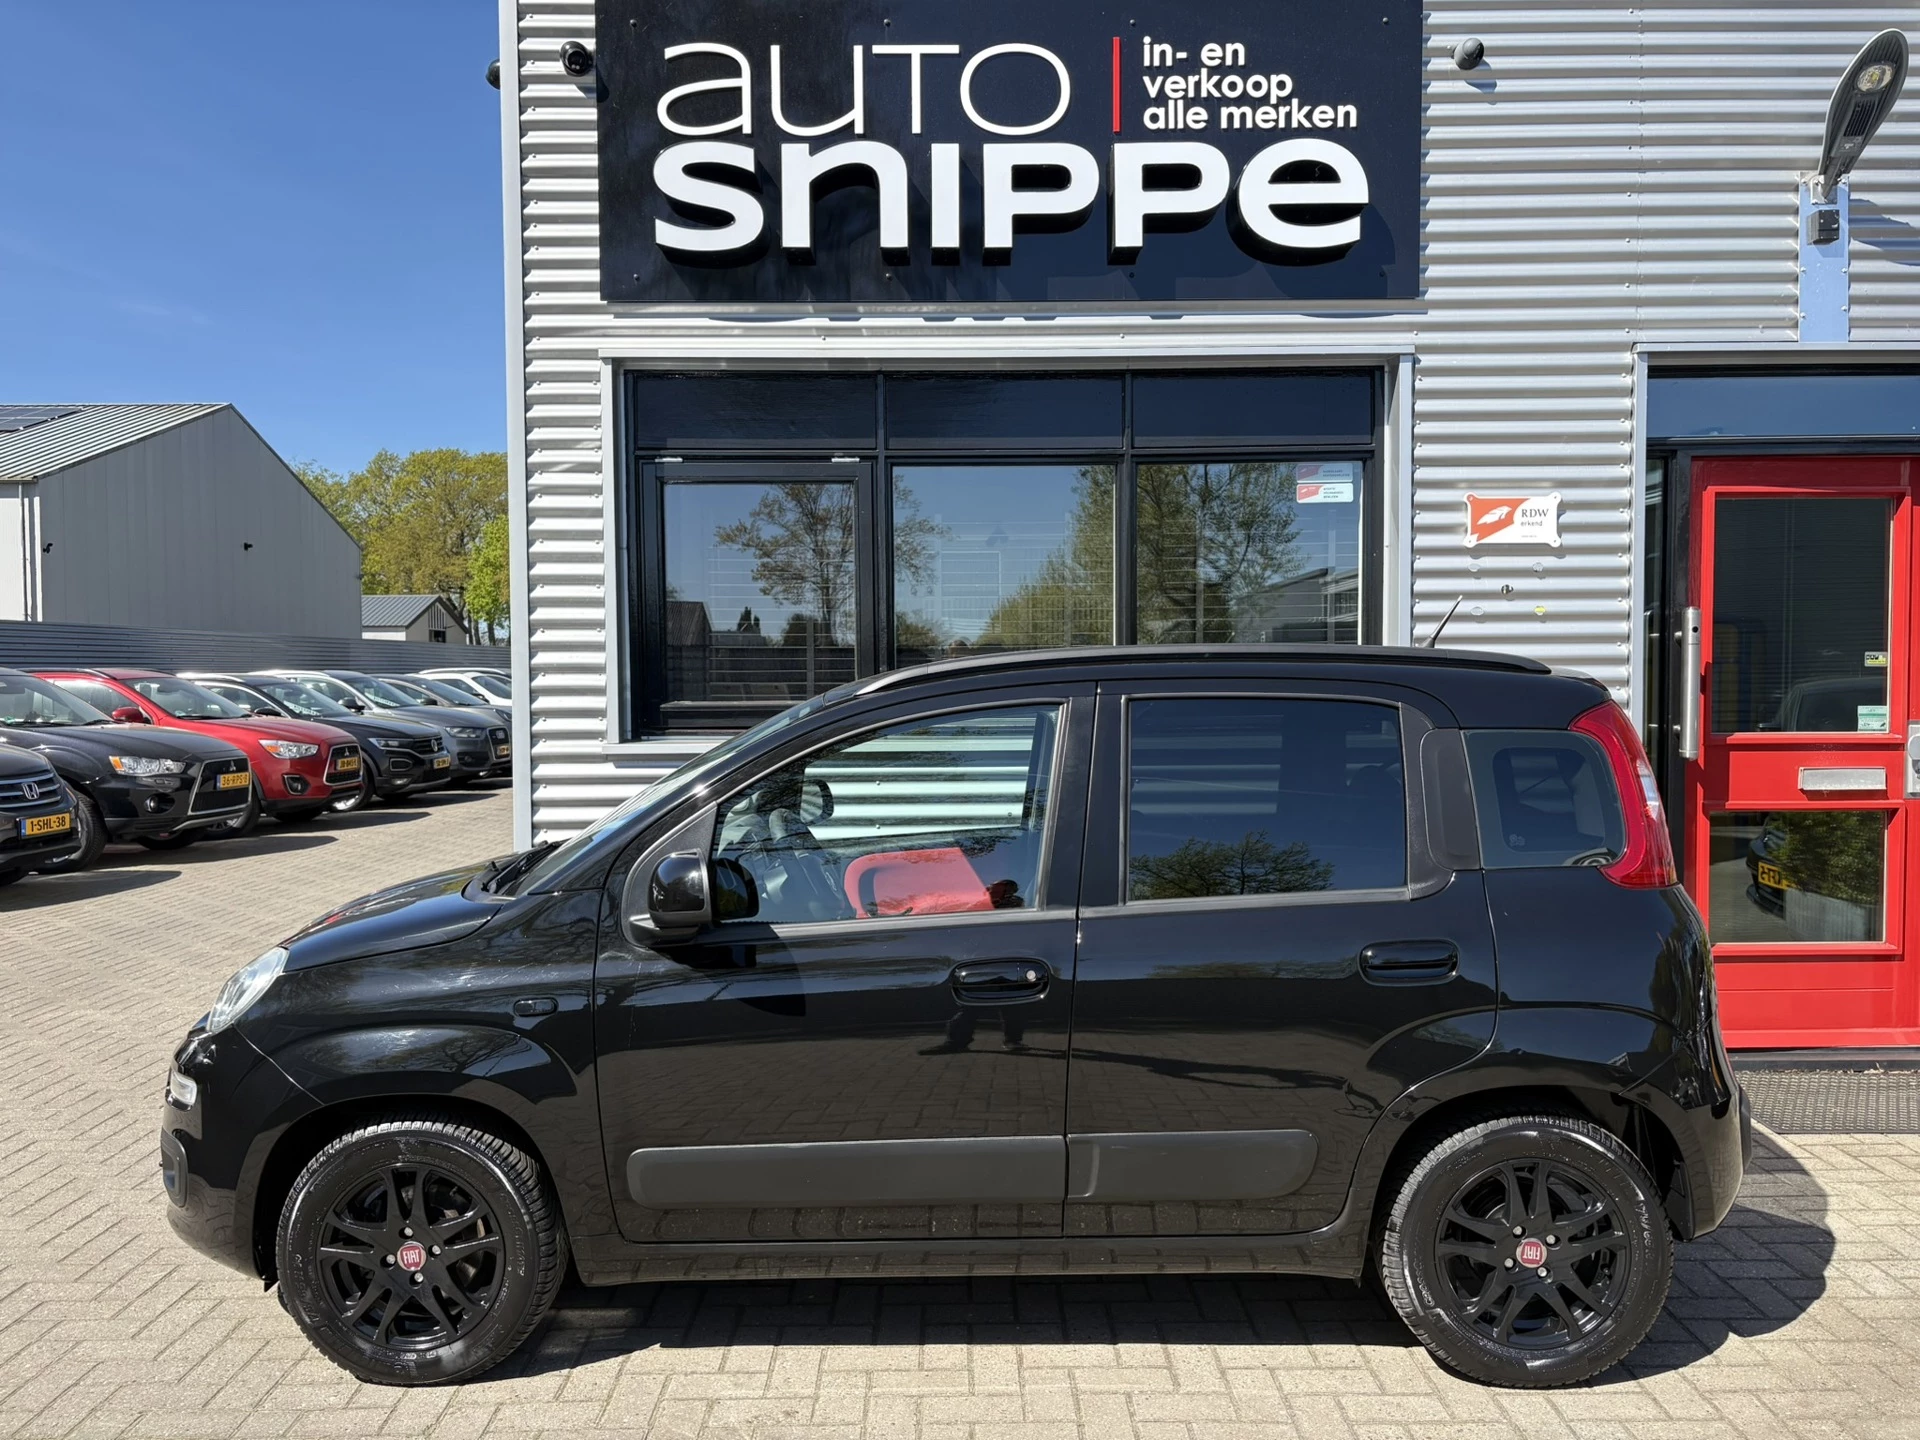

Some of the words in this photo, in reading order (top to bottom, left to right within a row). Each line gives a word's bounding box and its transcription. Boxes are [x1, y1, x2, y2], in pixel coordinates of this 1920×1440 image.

[1143, 36, 1188, 67] in-
[1201, 42, 1245, 67] en
[1143, 68, 1293, 105] verkoop
[1143, 99, 1209, 130] alle
[1220, 98, 1357, 129] merken
[1521, 508, 1550, 518] RDW
[30, 815, 67, 832] 1-SHL-38
[402, 1249, 420, 1265] FIAT
[1522, 1245, 1541, 1260] FIAT
